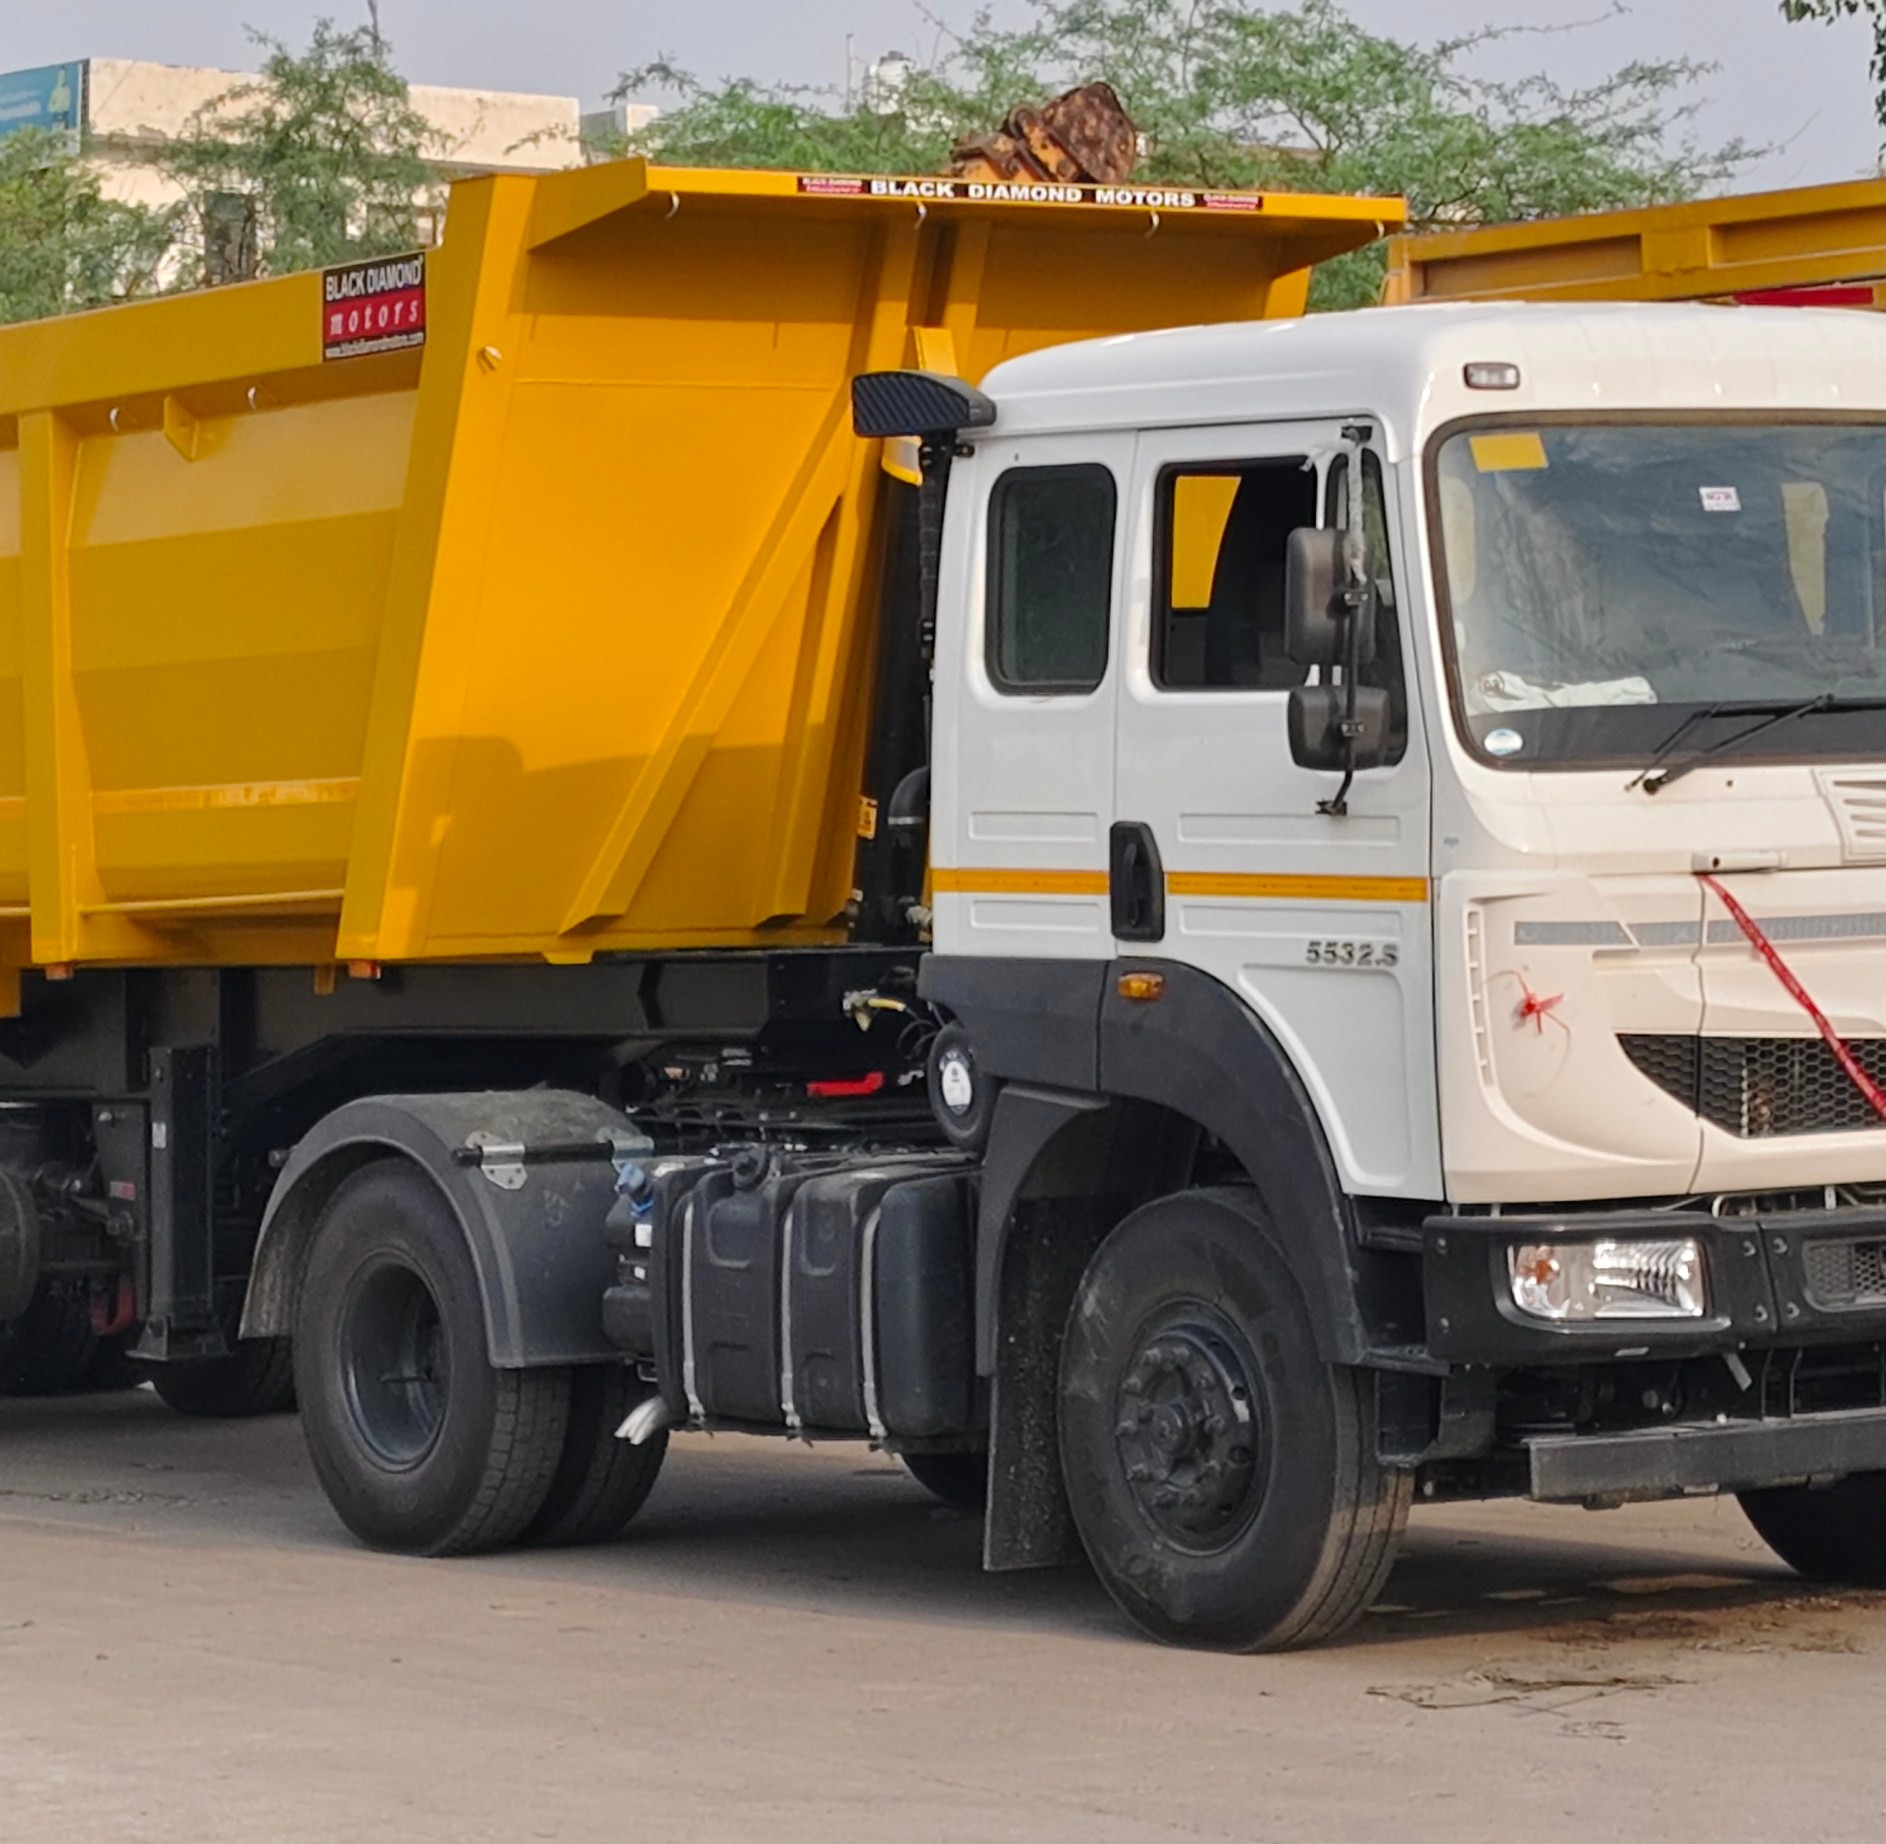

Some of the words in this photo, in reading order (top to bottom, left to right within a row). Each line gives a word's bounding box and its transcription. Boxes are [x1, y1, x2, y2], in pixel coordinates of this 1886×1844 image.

[870, 179, 955, 198] BLACK
[967, 183, 1082, 202] DIAMOND
[1095, 189, 1195, 207] MOTORS
[325, 270, 366, 302] BLACK
[366, 260, 422, 294] DIAMOND
[330, 299, 419, 336] motors
[1305, 941, 1399, 967] 5532.S
